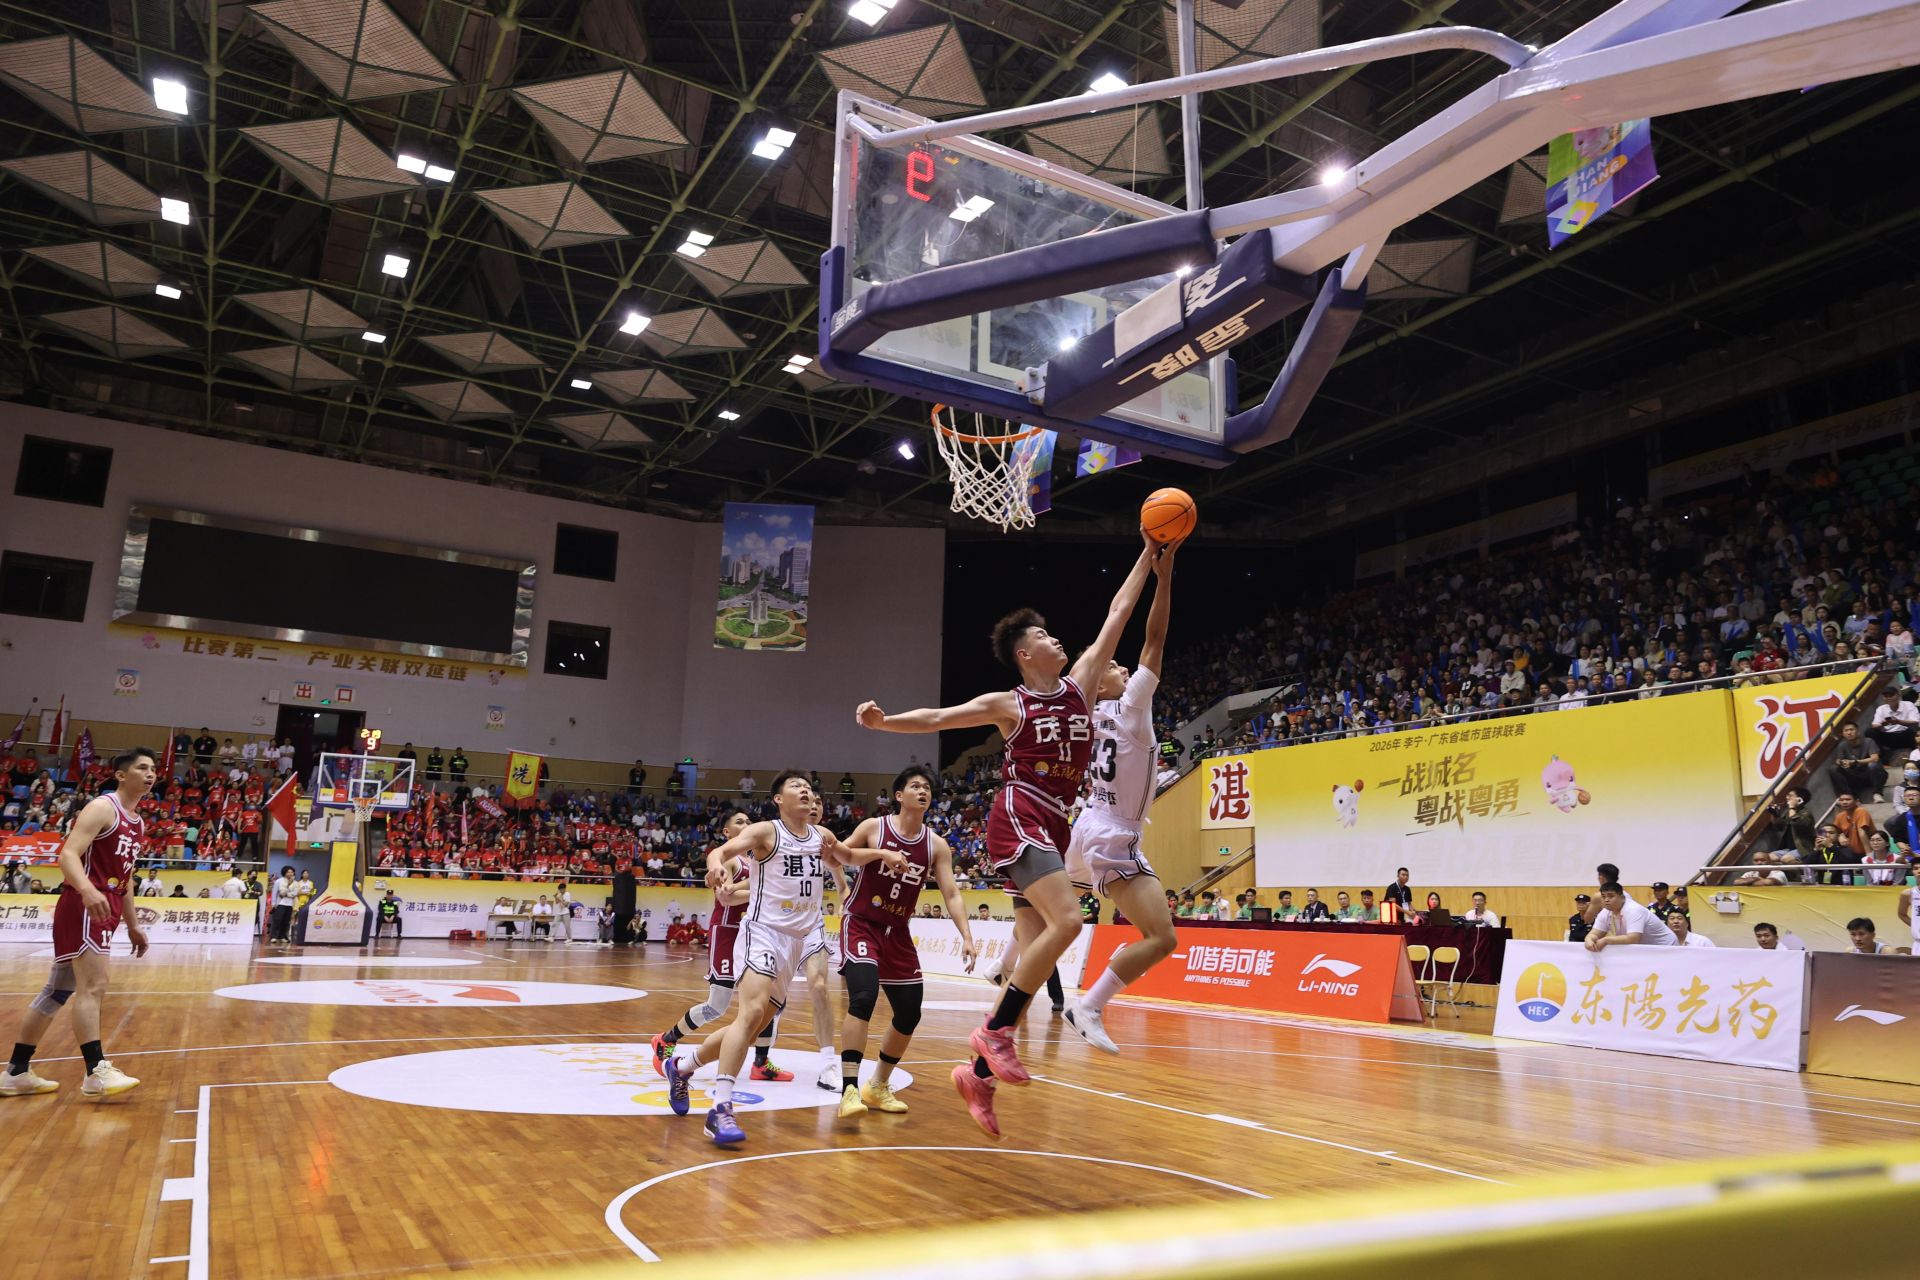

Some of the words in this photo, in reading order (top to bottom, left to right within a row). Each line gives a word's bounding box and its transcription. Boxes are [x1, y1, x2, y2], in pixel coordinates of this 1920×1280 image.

[183, 636, 279, 662] 比赛第二
[307, 651, 469, 682] 产业关联双延链
[296, 684, 312, 699] 出
[338, 688, 352, 702] 口
[1032, 714, 1090, 743] 茂名
[1369, 738, 1402, 752] 2026年
[1403, 722, 1527, 749] 李宁·广东省城市篮球联赛
[1757, 694, 1841, 780] 江
[1058, 742, 1072, 762] 11
[1376, 750, 1481, 798] 一战城名
[1209, 761, 1251, 821] 湛
[1413, 777, 1520, 832] 粤战粤勇
[783, 855, 822, 877] 湛江
[799, 881, 811, 897] 10
[889, 883, 901, 900] 6
[315, 909, 359, 917] LI-NING
[405, 902, 479, 913] 湛江市篮球协会
[163, 910, 240, 924] 海味鸡仔饼
[857, 942, 868, 956] 6
[721, 959, 730, 974] 2
[1171, 945, 1275, 976] 一切皆有可能
[1219, 977, 1252, 988] POSSIBLE
[1297, 980, 1359, 996] LI-NING
[1527, 1005, 1550, 1017] HEC
